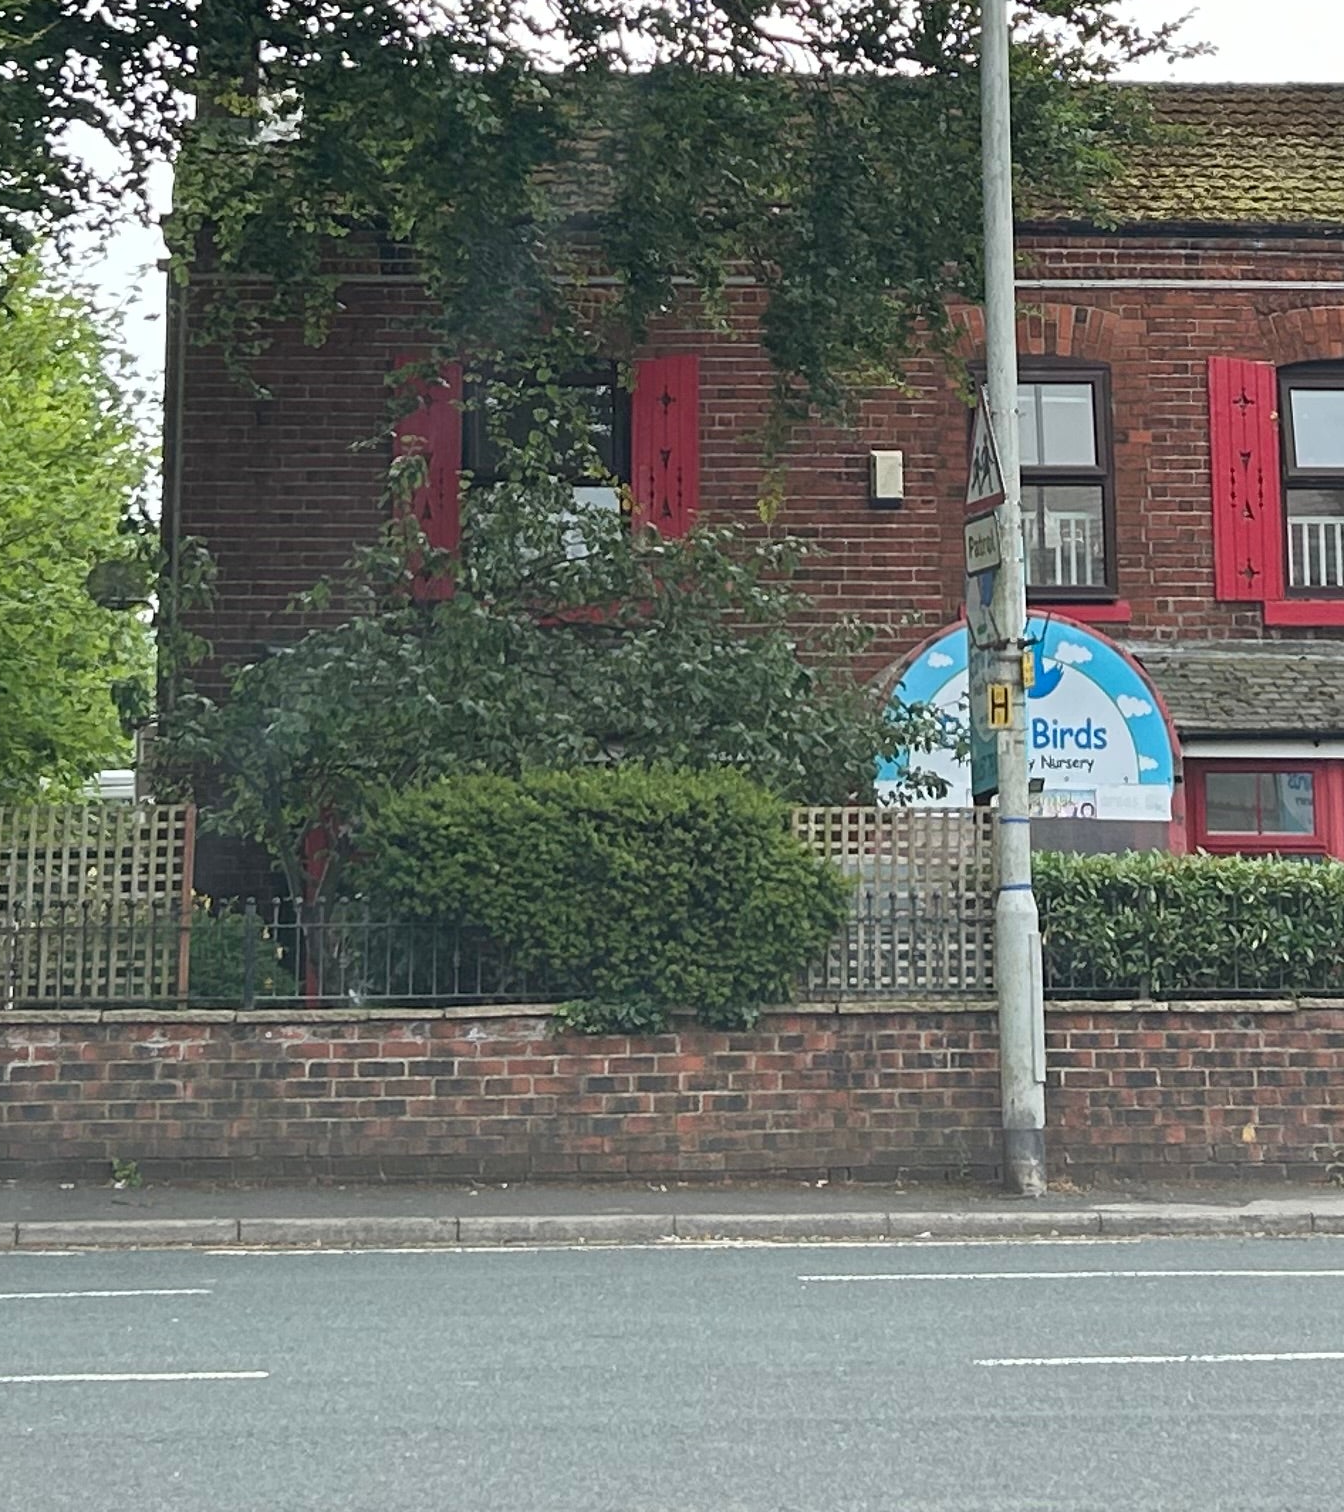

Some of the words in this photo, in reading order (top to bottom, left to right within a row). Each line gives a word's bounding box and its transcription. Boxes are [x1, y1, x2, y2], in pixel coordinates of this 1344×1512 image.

[968, 529, 996, 559] Patrol
[991, 688, 1008, 724] H
[1032, 717, 1108, 750] Birds
[1040, 754, 1094, 773] Nursery
